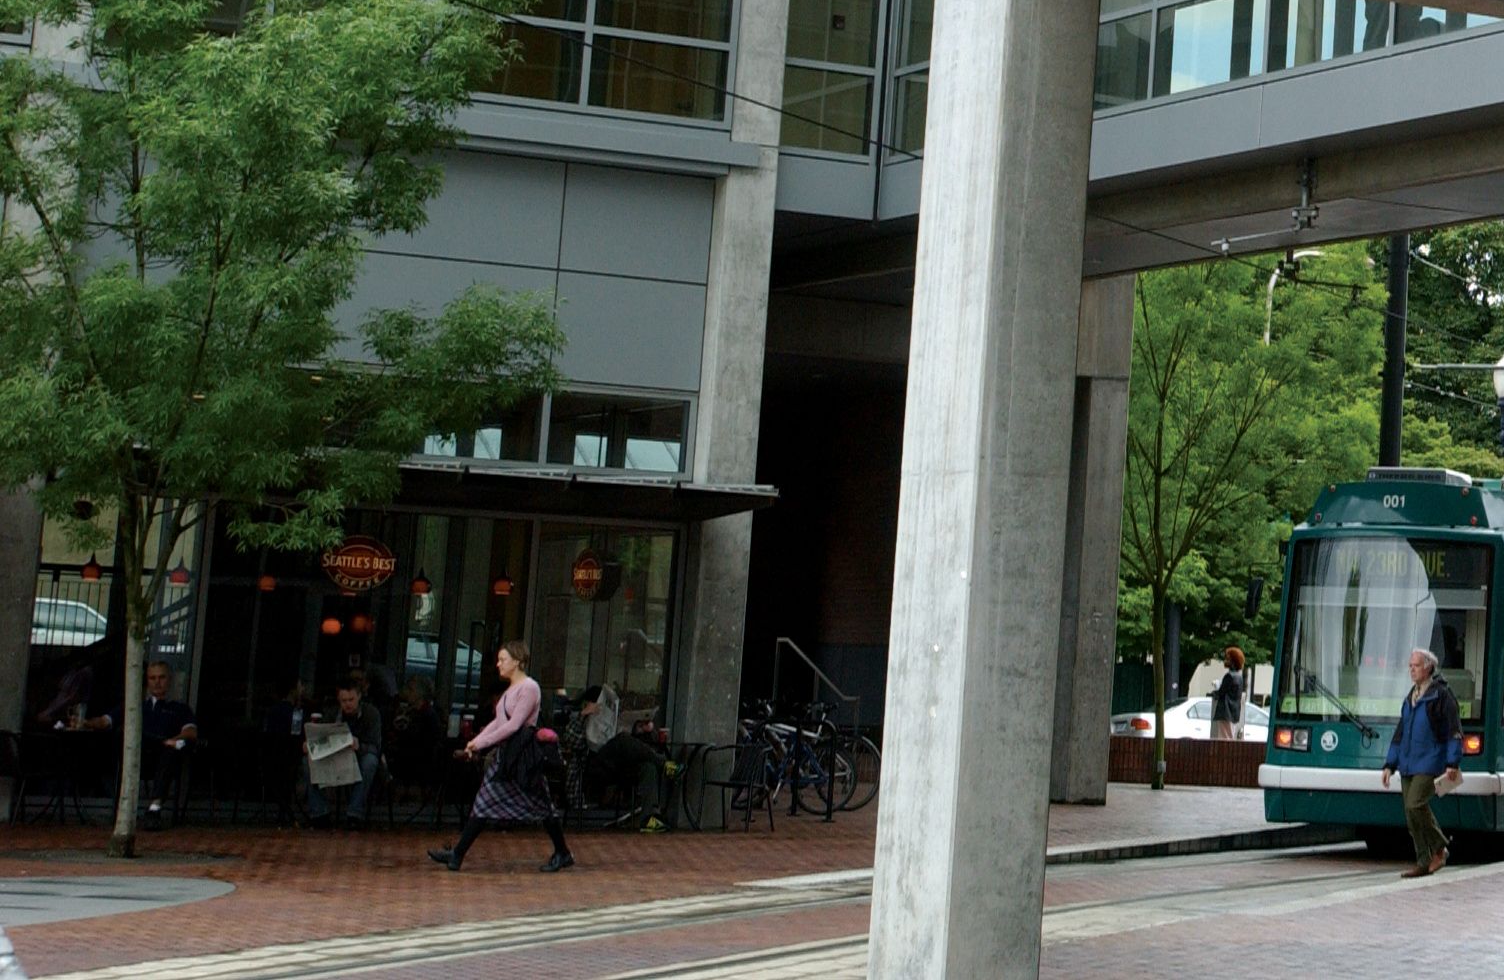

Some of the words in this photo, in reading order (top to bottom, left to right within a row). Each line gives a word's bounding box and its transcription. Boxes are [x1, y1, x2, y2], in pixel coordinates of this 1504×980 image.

[1383, 495, 1406, 508] 001
[322, 552, 370, 569] SEATTLE'S
[372, 557, 397, 571] BEST
[1366, 549, 1409, 576] 23RD
[335, 573, 380, 588] COFFEE
